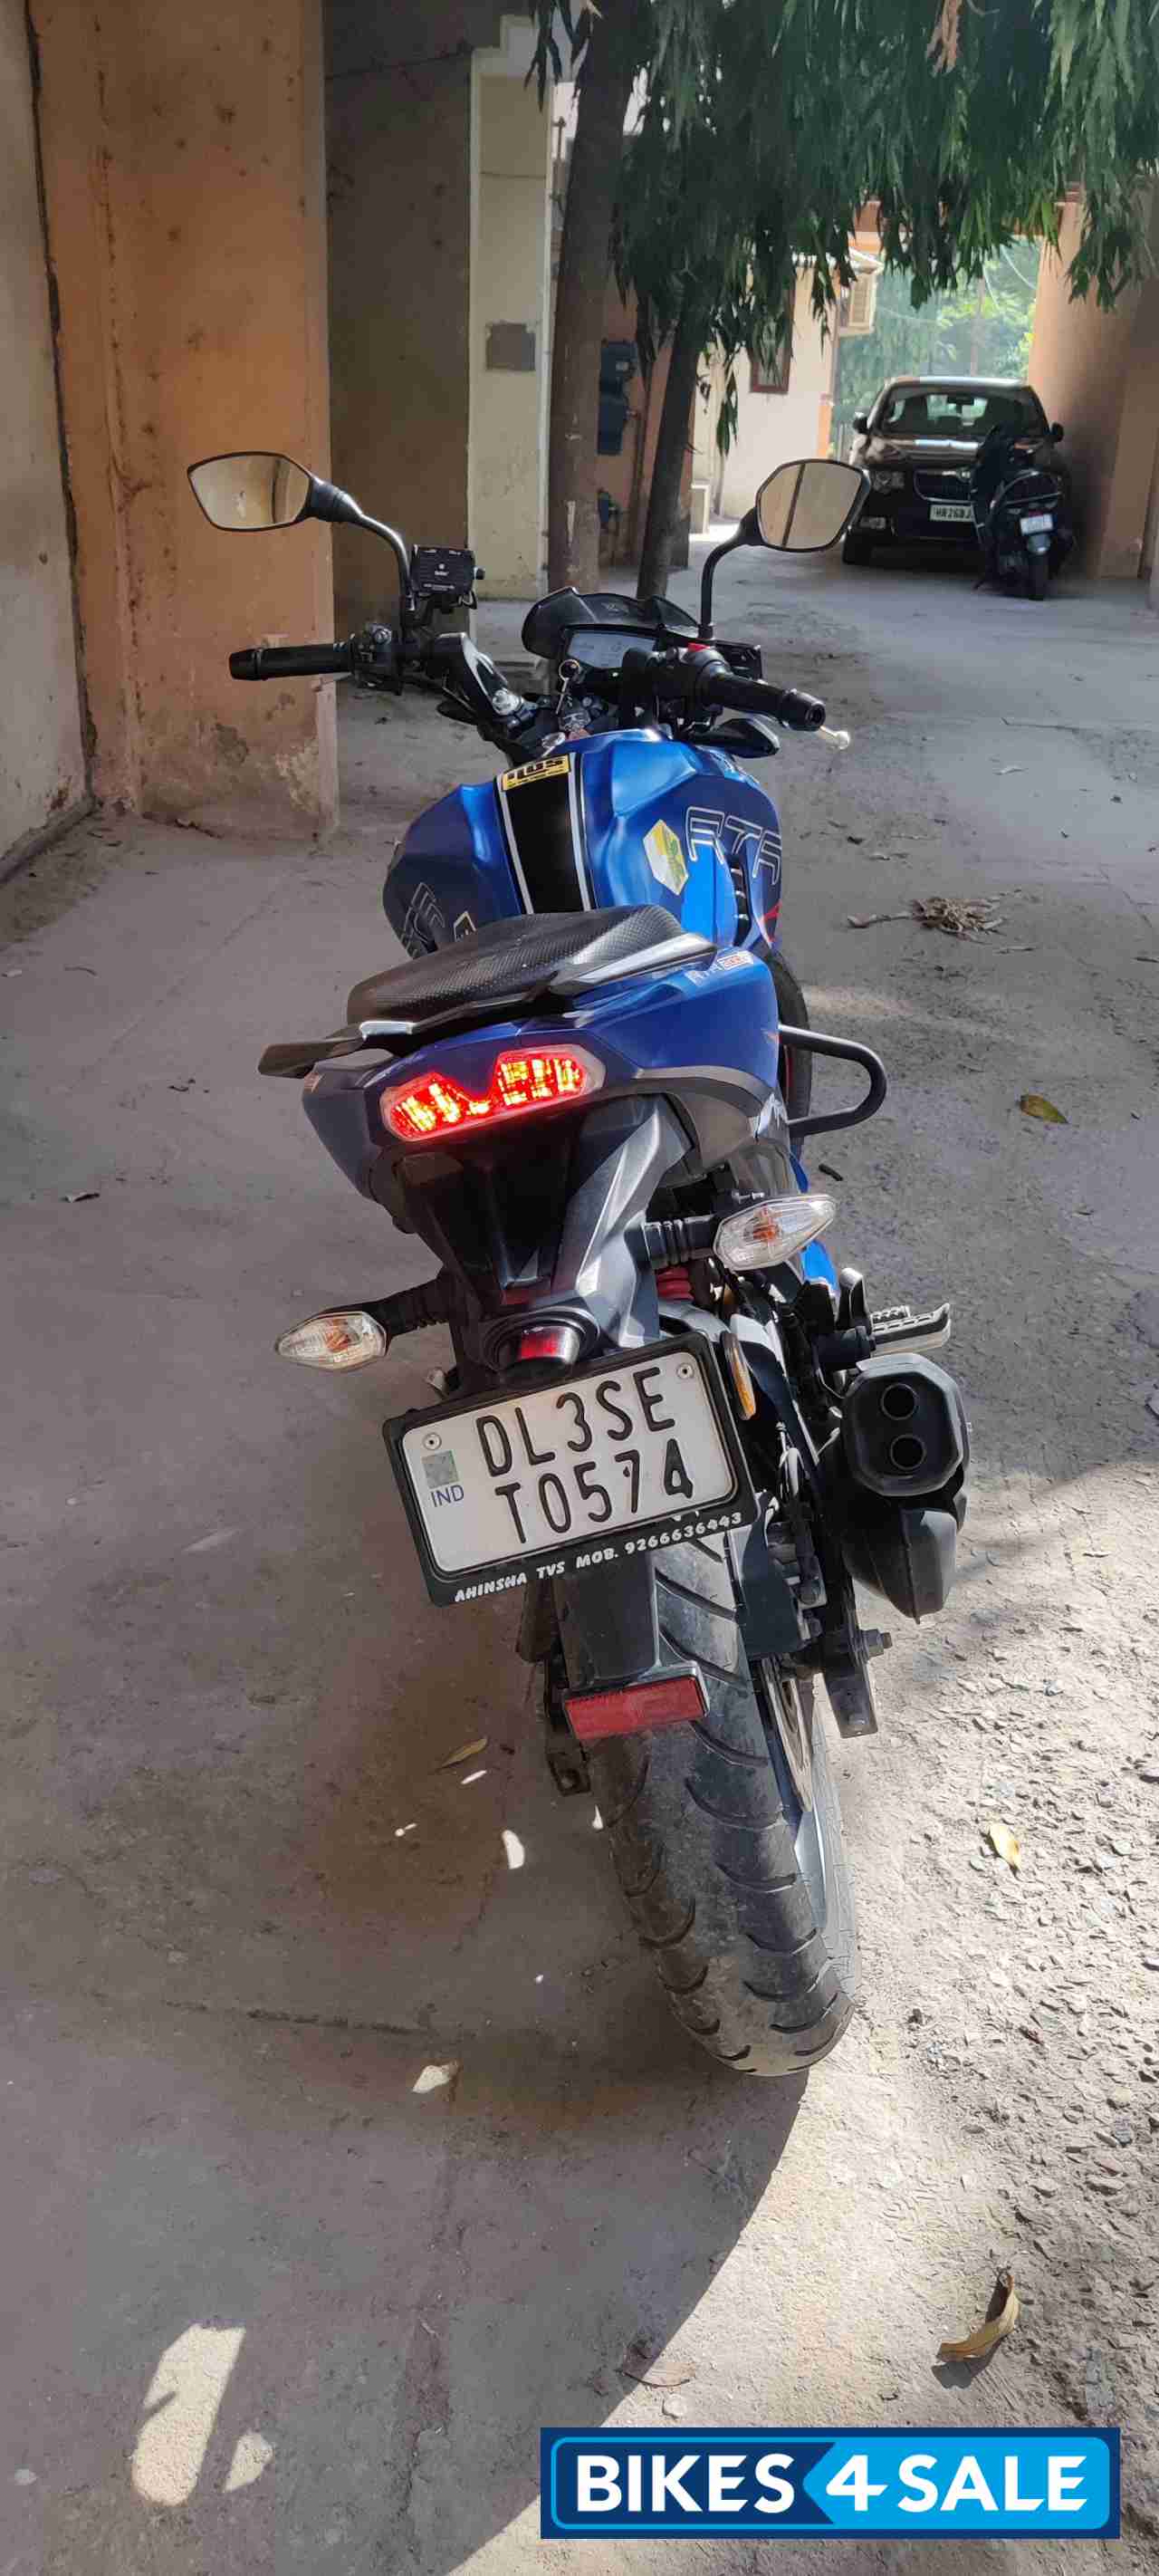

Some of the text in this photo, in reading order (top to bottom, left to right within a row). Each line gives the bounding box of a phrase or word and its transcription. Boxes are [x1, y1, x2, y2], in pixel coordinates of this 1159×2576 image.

[430, 1484, 465, 1508] IND
[495, 1438, 694, 1544] T0574
[455, 1512, 742, 1602] AHINSHA TVS MOB. 9266636443
